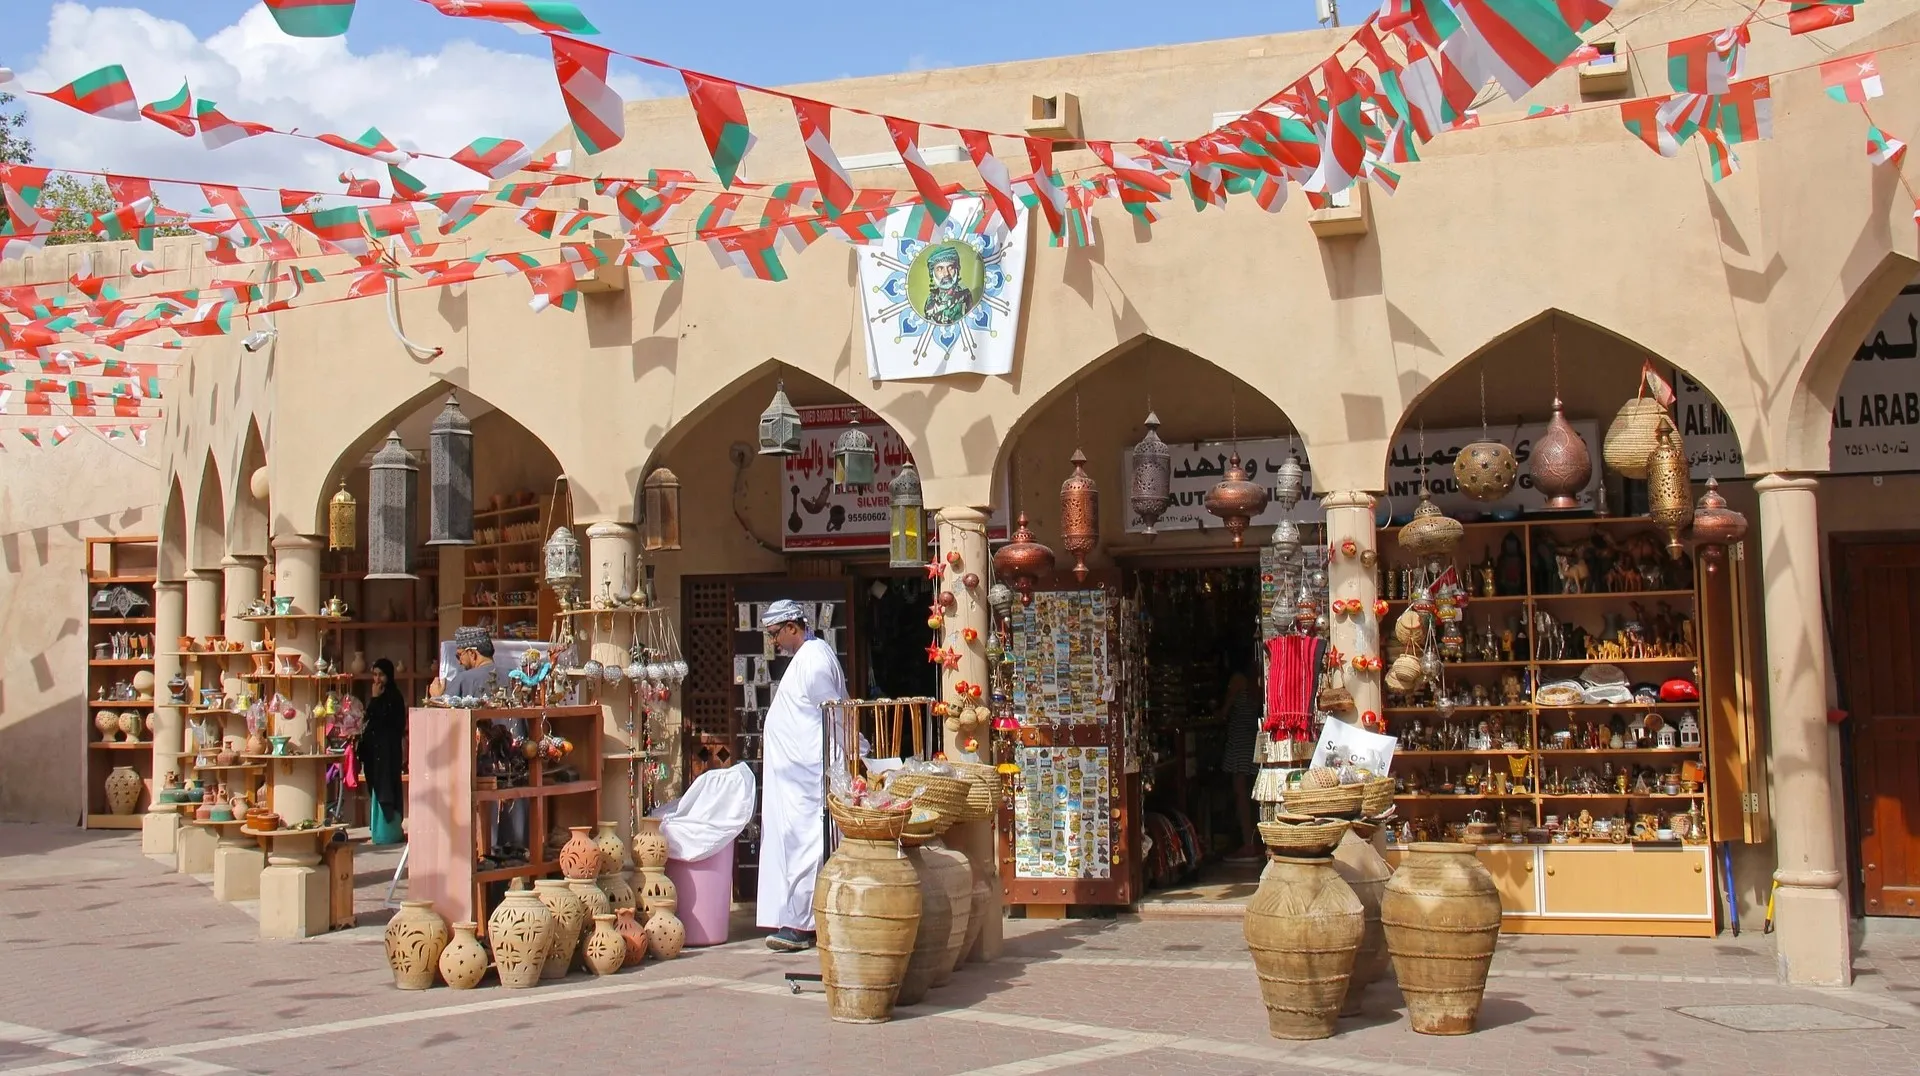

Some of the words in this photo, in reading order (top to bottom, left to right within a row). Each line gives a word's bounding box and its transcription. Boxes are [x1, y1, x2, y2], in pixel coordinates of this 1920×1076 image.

[1387, 478, 1459, 497] NTIQU
[857, 496, 890, 508] SILVER
[847, 512, 887, 523] 95560602
